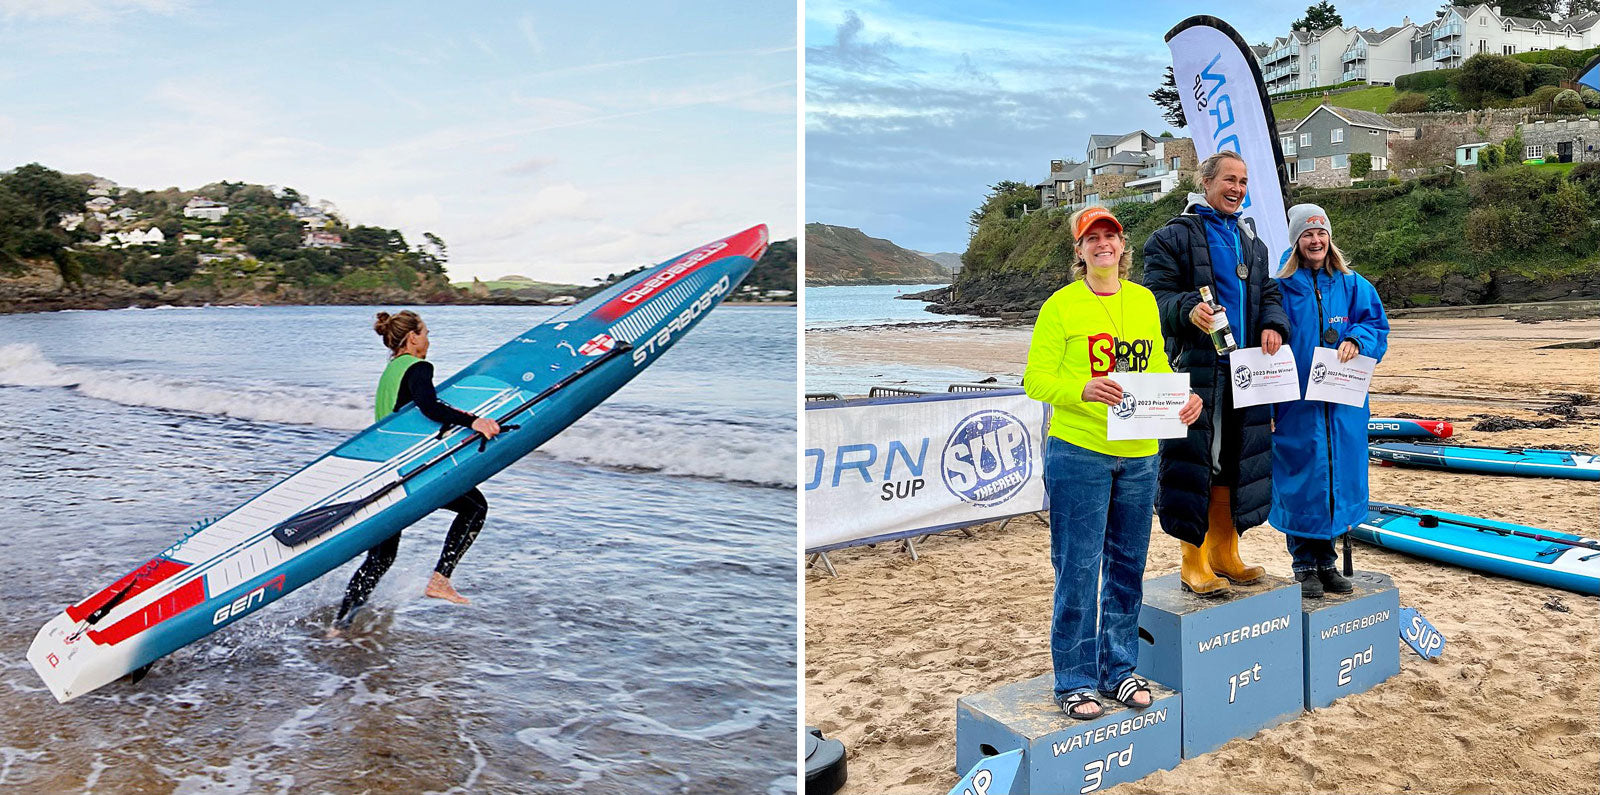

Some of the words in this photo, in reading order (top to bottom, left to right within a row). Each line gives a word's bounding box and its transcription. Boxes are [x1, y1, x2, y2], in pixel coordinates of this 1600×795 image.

[944, 424, 1023, 493] SUP
[881, 478, 925, 501] SUP
[212, 586, 266, 626] GEN
[1320, 609, 1391, 641] WATERBORN
[1197, 614, 1291, 654] WATERBORN
[1405, 615, 1442, 655] SUP
[1227, 662, 1263, 704] 1st
[1337, 645, 1374, 687] 2nd
[1051, 707, 1168, 758] WATERBORN
[1079, 743, 1134, 794] 3rd
